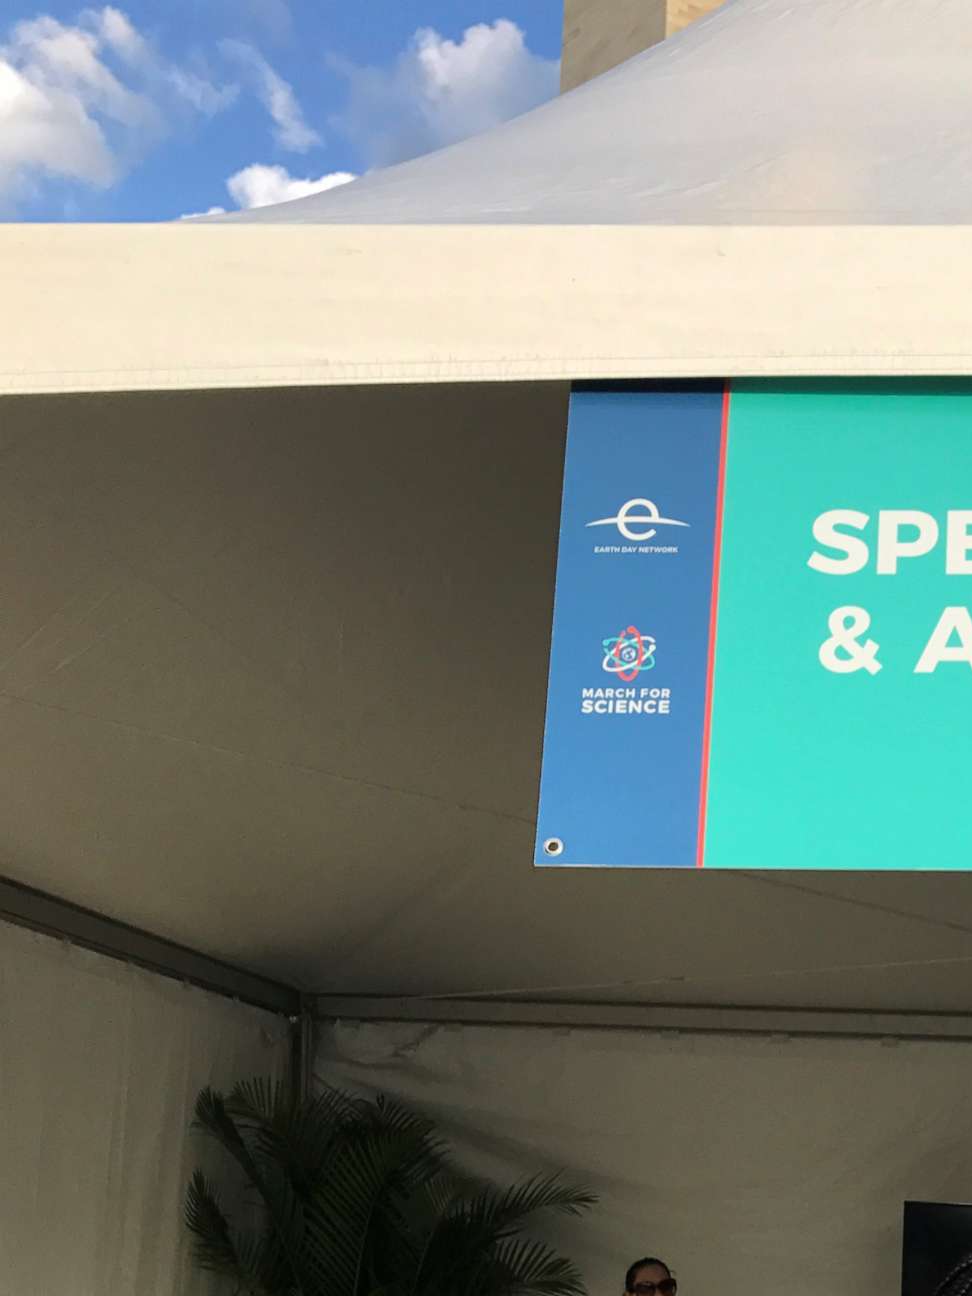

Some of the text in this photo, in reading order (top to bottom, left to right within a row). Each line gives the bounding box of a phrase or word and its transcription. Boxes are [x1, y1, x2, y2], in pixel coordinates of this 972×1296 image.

[819, 606, 883, 675] &
[582, 688, 670, 698] MARCH FOR
[581, 700, 670, 714] SCIENCE
